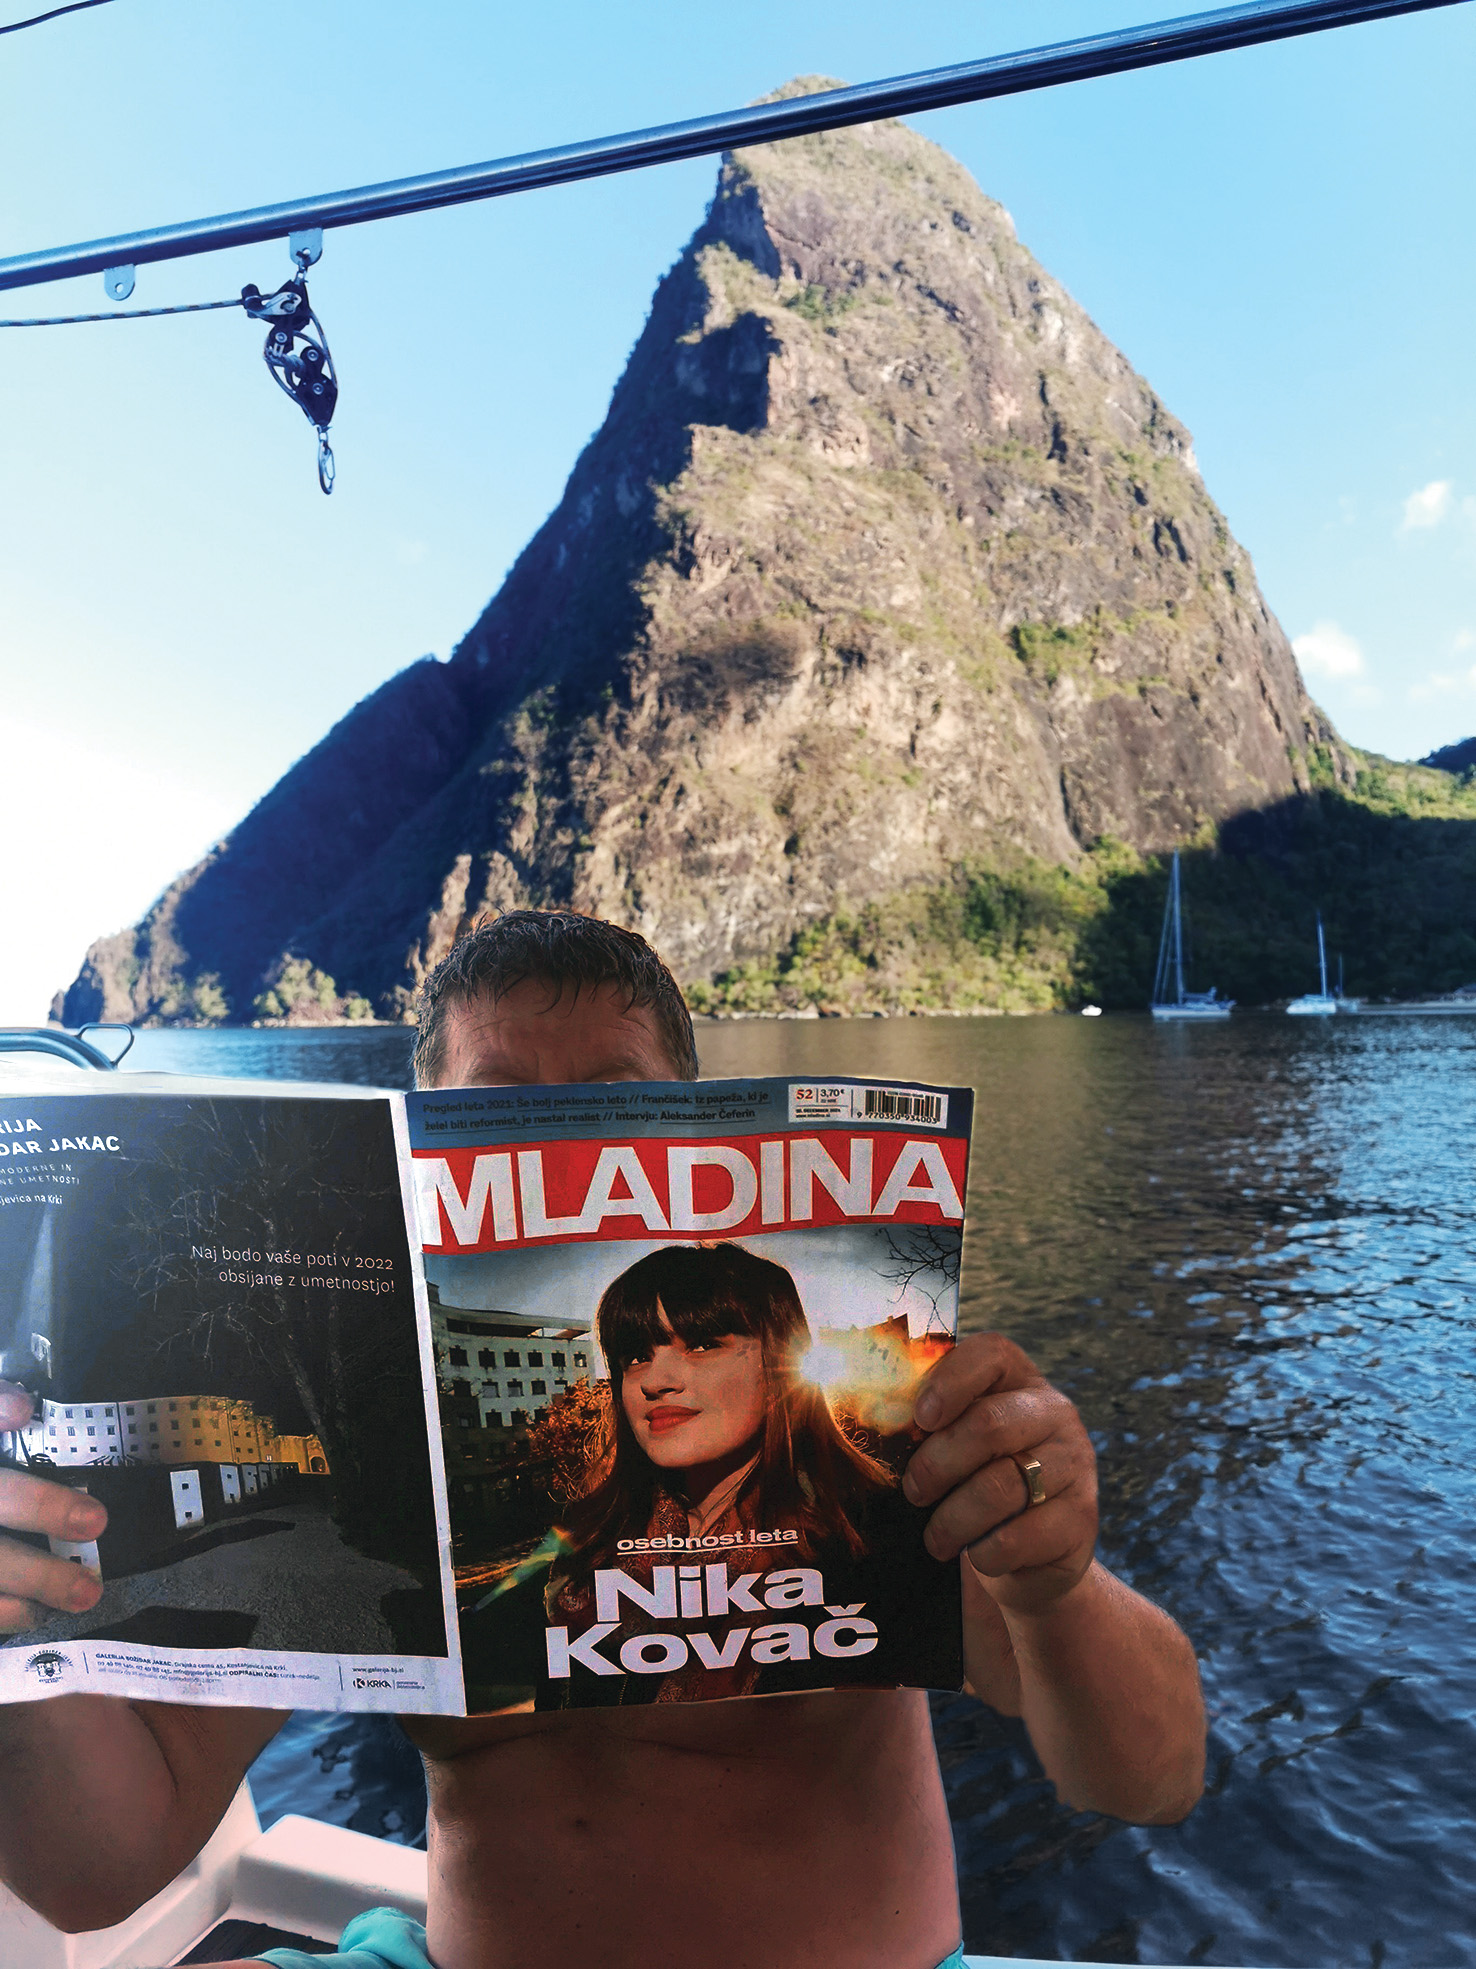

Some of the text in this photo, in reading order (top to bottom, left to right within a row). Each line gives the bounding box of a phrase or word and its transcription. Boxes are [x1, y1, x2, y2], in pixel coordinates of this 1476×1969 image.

[423, 1102, 462, 1114] Pregled
[464, 1100, 484, 1111] leta
[487, 1099, 514, 1110] 2021:
[517, 1096, 530, 1107] Še
[532, 1097, 550, 1109] bolj
[553, 1095, 604, 1107] peklensko
[607, 1095, 626, 1105] leto
[706, 1092, 746, 1105] papeža,
[748, 1091, 757, 1101] ki
[758, 1090, 769, 1104] je
[796, 1088, 813, 1099] 52
[425, 1120, 448, 1131] želel
[451, 1120, 467, 1130] biti
[470, 1116, 520, 1129] reformist,
[521, 1115, 531, 1127] je
[534, 1113, 566, 1124] nastal
[568, 1112, 600, 1123] realist
[616, 1111, 658, 1123] Intervju:
[660, 1110, 718, 1121] Aleksander
[719, 1107, 756, 1119] Čeferin
[857, 1111, 863, 1119] 9
[868, 1112, 901, 1120] 770350
[49, 1135, 121, 1152] JAKAC
[61, 1163, 72, 1172] IN
[20, 1174, 80, 1185] UMETNOSTI
[34, 1194, 46, 1204] na
[47, 1194, 63, 1205] Krki
[412, 1137, 964, 1246] MLADINA
[192, 1245, 394, 1270] Naj bodo vaše poti v 2022
[218, 1269, 396, 1296] obsijane z umetnostjo!
[616, 1528, 798, 1551] osebnost leta
[594, 1562, 825, 1622] Nika
[545, 1602, 879, 1679] Kovač
[367, 1679, 392, 1688] KRKA
